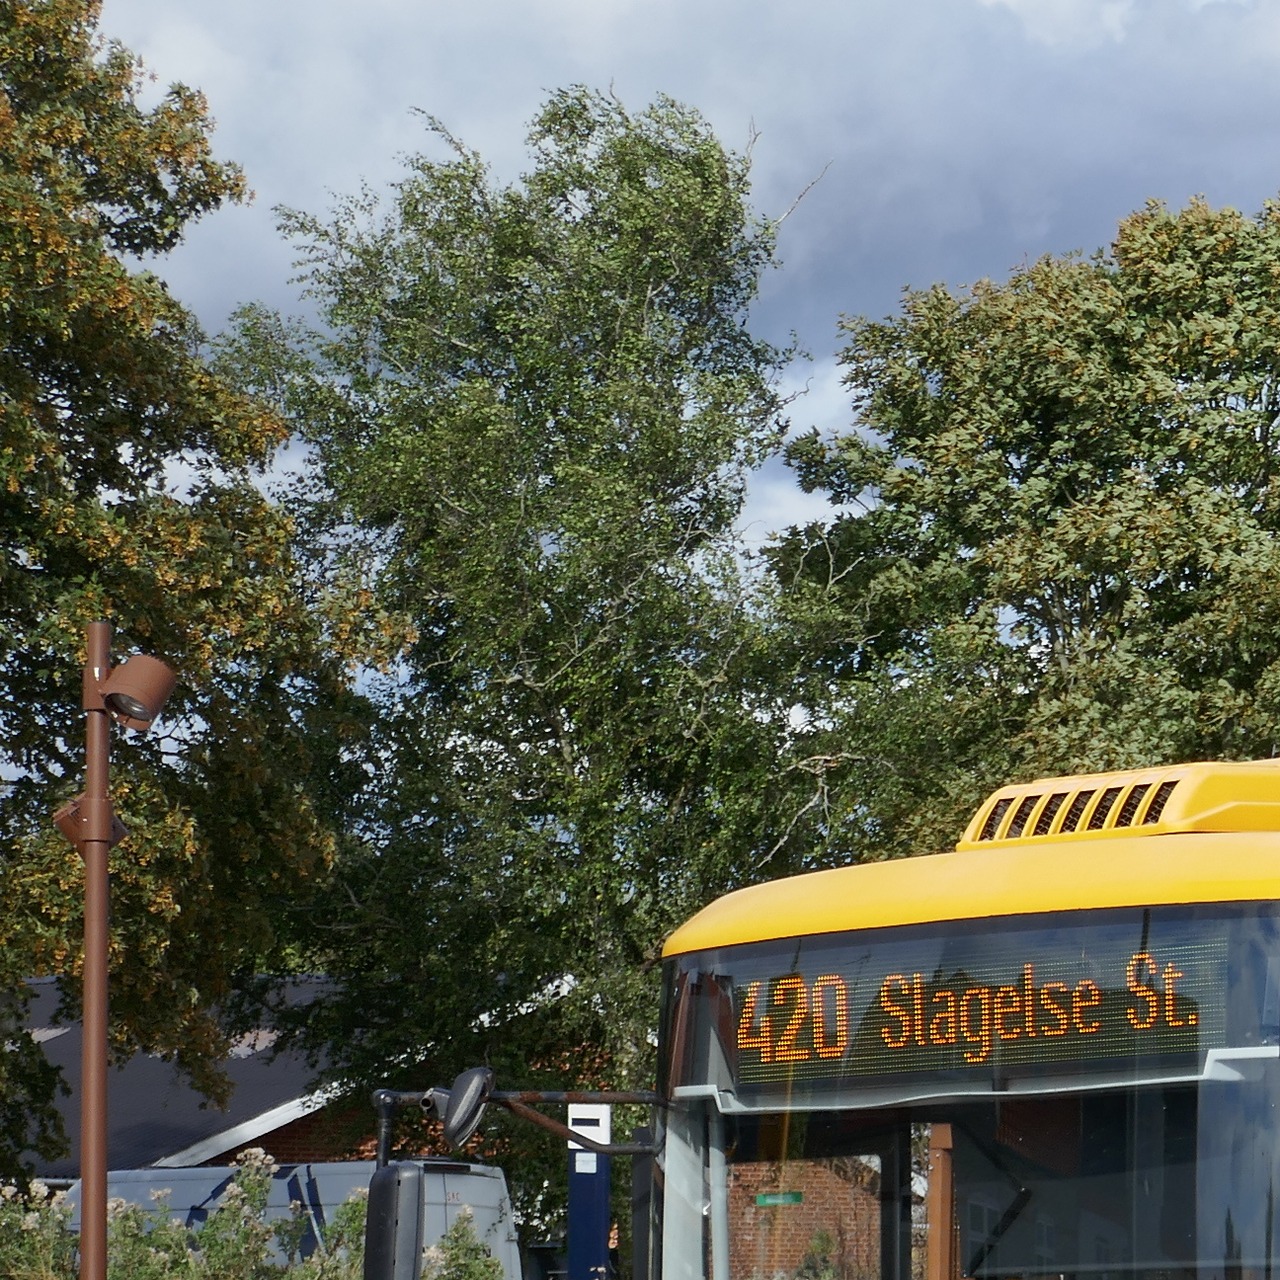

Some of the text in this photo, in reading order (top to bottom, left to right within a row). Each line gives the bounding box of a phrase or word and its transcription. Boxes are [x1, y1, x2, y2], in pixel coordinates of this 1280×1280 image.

[737, 951, 1198, 1063] 420 Slagelse St.
